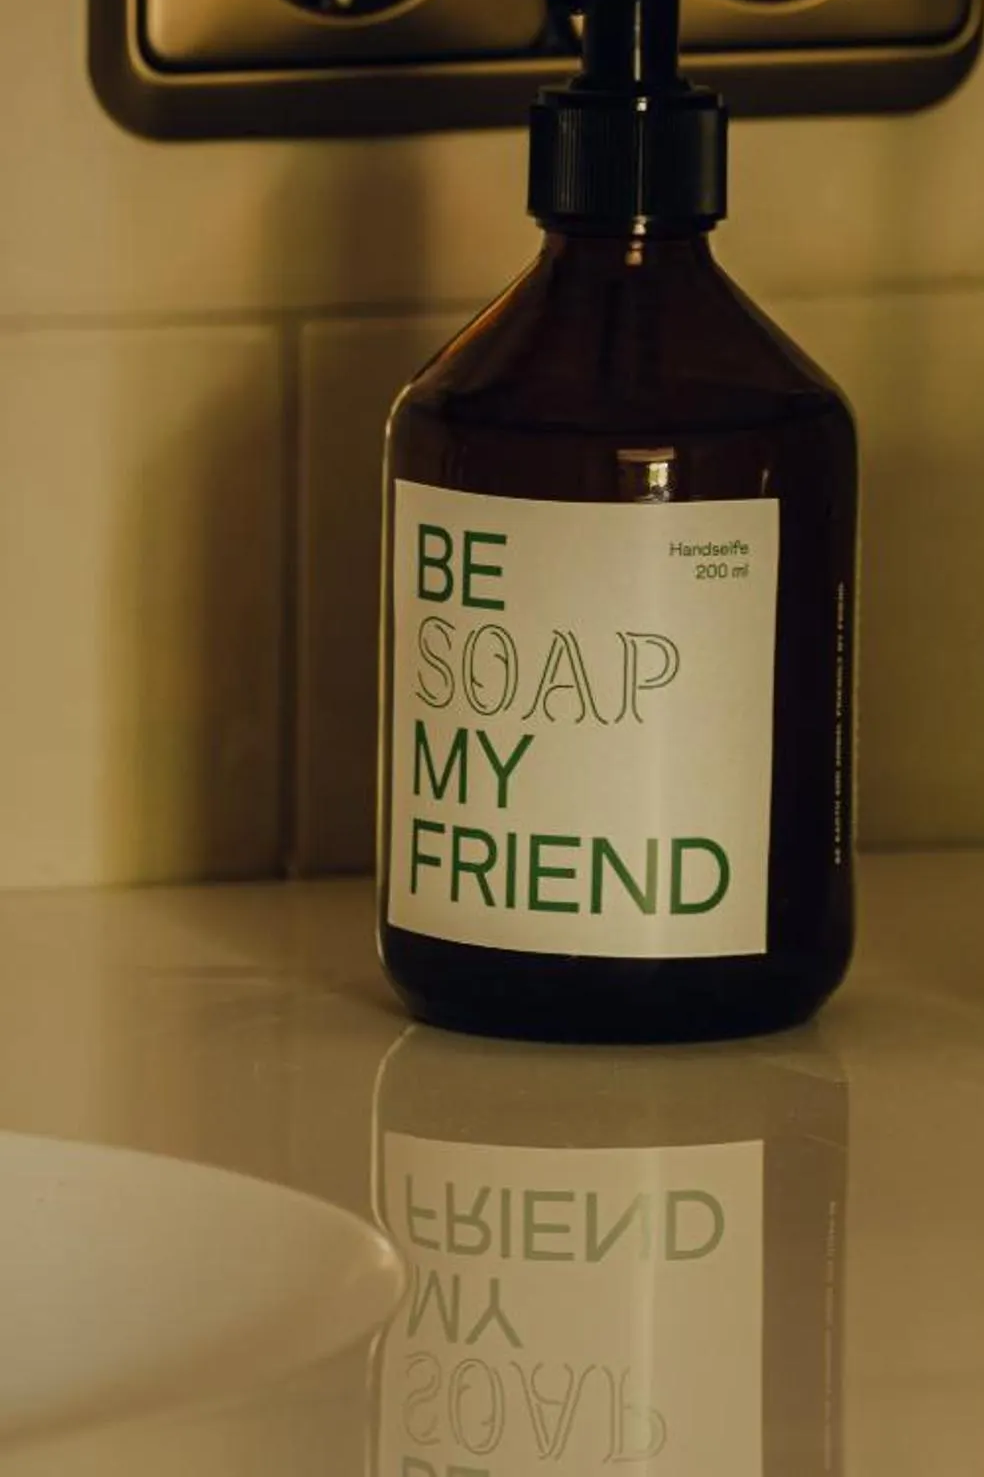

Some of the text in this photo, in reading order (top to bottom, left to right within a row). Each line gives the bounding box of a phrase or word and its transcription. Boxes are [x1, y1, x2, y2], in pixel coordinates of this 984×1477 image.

[418, 523, 508, 611] BE
[668, 540, 750, 557] Handseife
[695, 563, 750, 580] 200 ml
[415, 616, 680, 725] SOAP
[413, 720, 535, 809] MY
[410, 818, 731, 916] FRIEND
